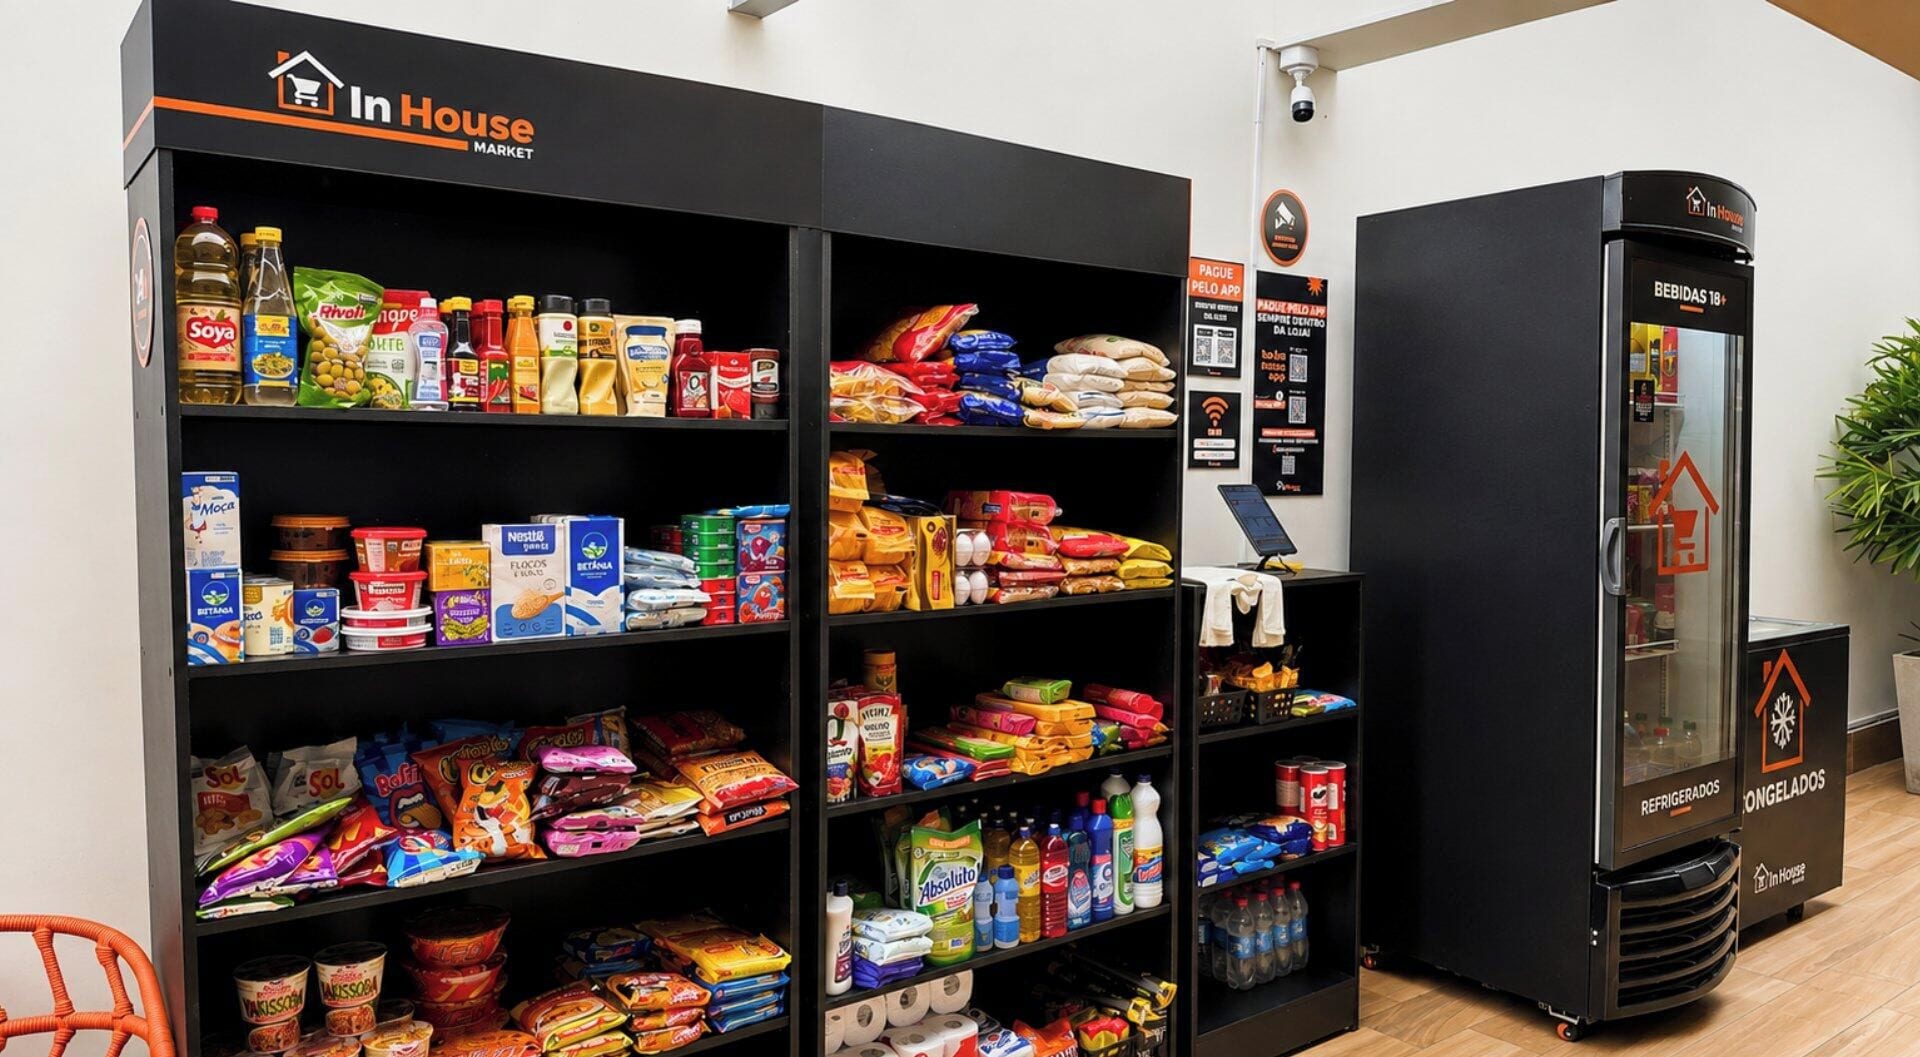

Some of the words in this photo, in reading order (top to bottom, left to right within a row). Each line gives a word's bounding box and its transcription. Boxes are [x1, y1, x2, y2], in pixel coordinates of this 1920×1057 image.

[350, 85, 391, 123] In
[401, 93, 535, 144] House
[473, 141, 534, 160] MARKET
[1707, 201, 1716, 218] In
[1199, 263, 1234, 279] PAGUE
[1191, 279, 1218, 294] PELO
[1221, 283, 1241, 297] APP
[1654, 280, 1707, 304] BEBIDAS
[1708, 290, 1727, 306] 18+
[319, 304, 366, 319] Rivoli
[1257, 312, 1291, 325] SEMPRE
[189, 321, 235, 343] Soya
[1273, 324, 1286, 335] DA
[200, 501, 235, 516] Moça
[1641, 779, 1720, 816] REFRIGERADOS
[1742, 768, 1825, 815] ONGELADOS
[1769, 871, 1779, 888] In
[1779, 862, 1806, 884] House
[919, 866, 977, 905] Absoluto
